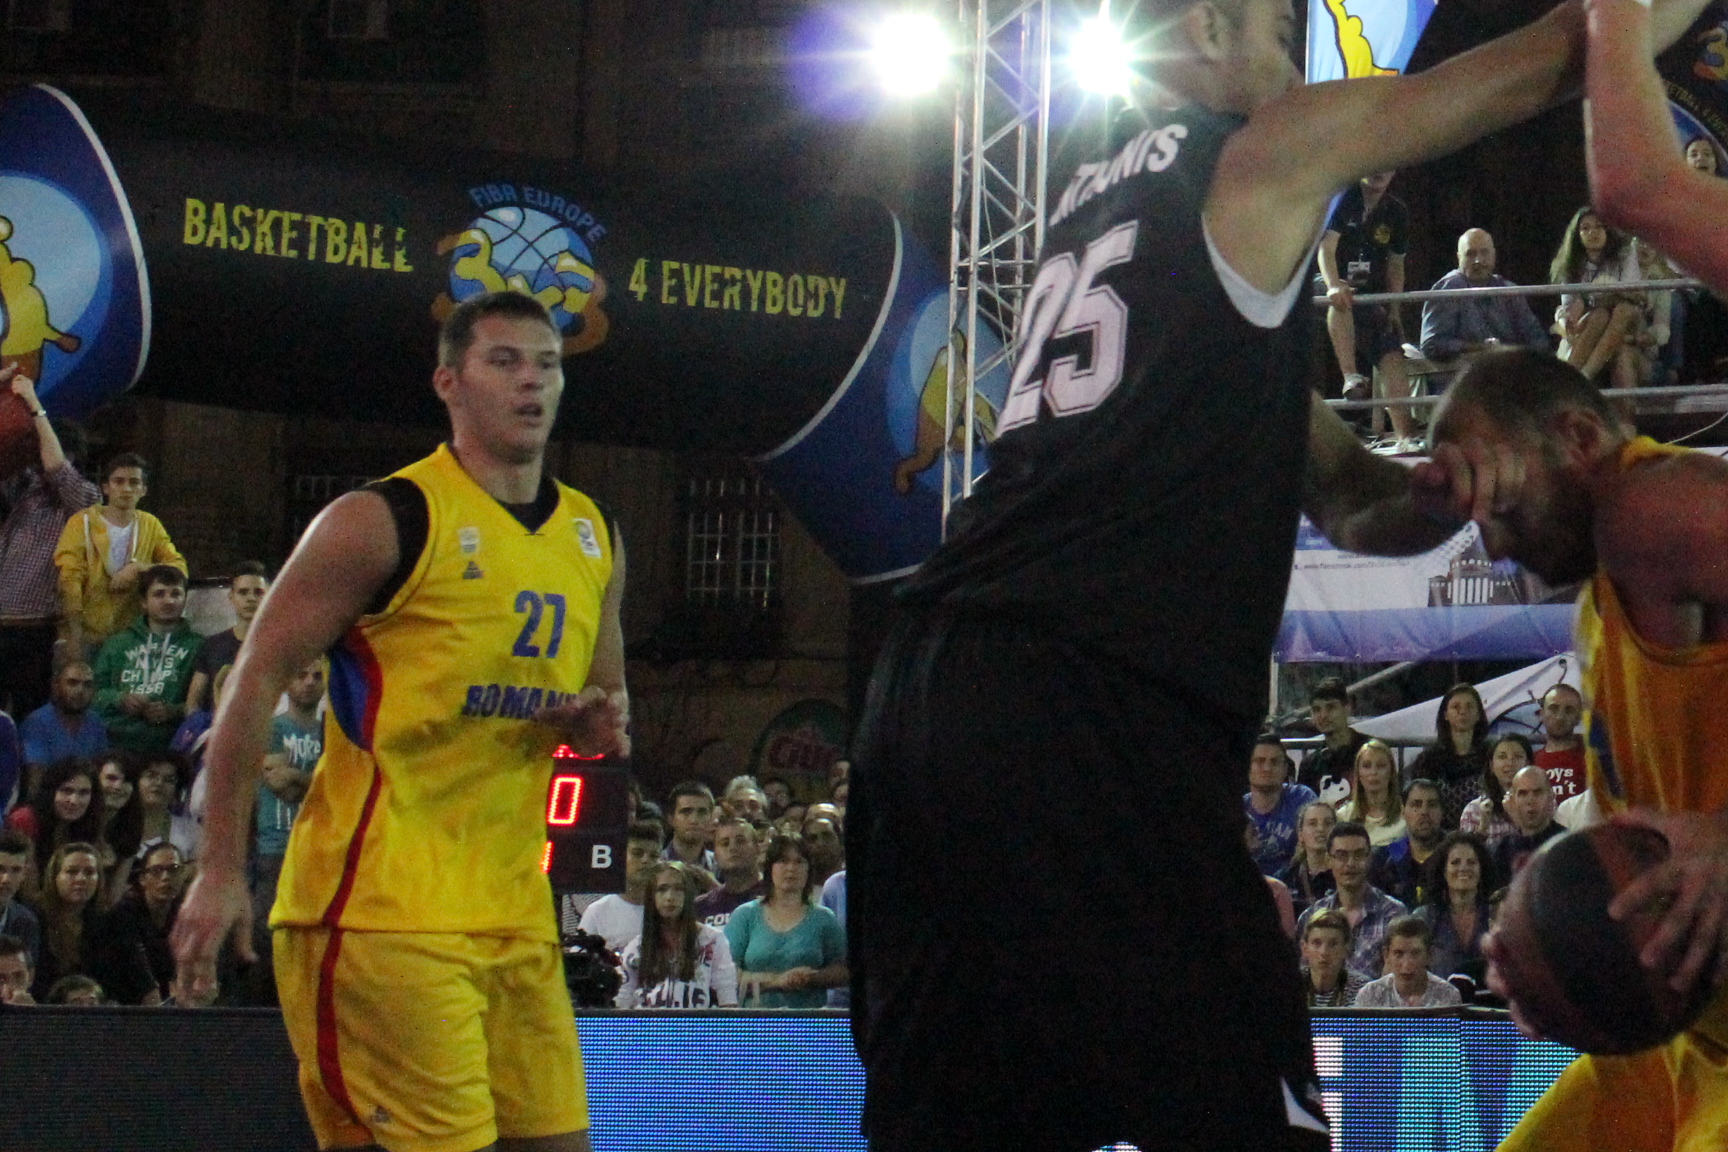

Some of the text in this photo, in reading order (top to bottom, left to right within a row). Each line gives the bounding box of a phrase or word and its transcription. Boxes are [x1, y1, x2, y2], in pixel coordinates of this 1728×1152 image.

[469, 184, 606, 243] FIBA EUROPE
[183, 197, 848, 319] BASKETBALL 4 EVERYBODY
[994, 219, 1139, 436] 25
[512, 590, 567, 658] 27
[591, 843, 613, 869] B
